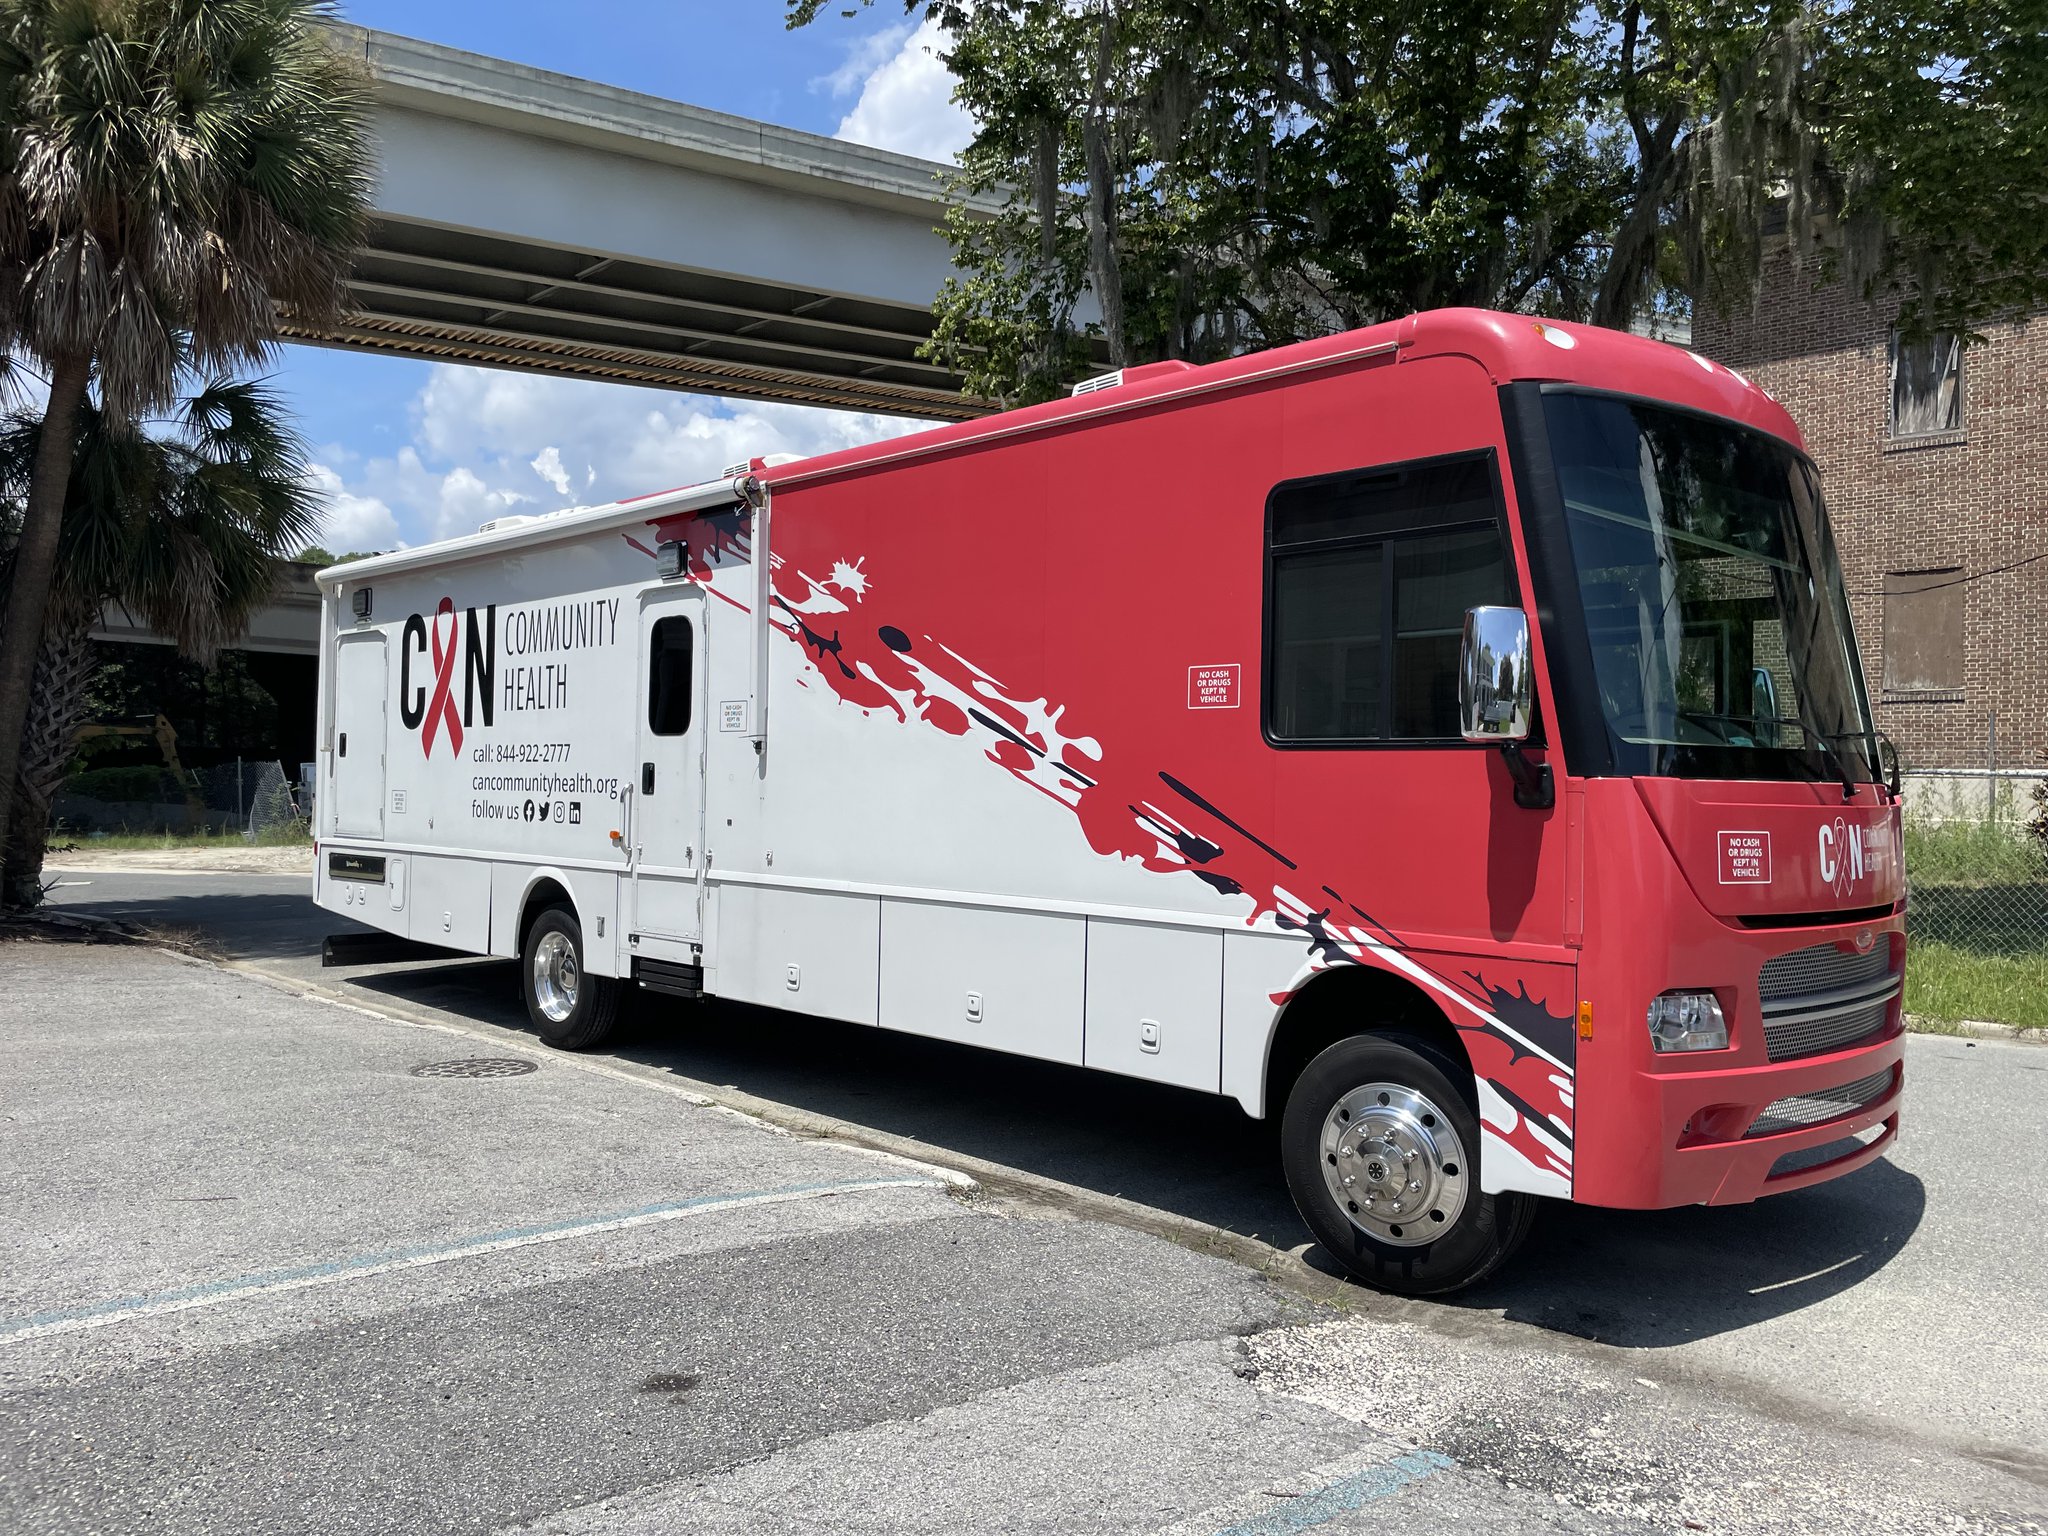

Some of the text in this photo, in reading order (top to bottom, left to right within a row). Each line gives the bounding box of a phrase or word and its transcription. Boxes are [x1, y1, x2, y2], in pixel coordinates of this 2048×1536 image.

[505, 597, 620, 656] COMMUNITY
[1199, 671, 1210, 679] NO
[1197, 678, 1231, 687] OR DRUGS
[504, 663, 568, 712] HEALTH
[1201, 687, 1217, 695] KEPT
[1200, 695, 1227, 703] VEHICLE
[473, 743, 571, 763] call: 844-922-2777
[472, 772, 618, 800] cancommunityhealth.org
[472, 799, 504, 819] follow
[507, 804, 519, 820] us
[1730, 838, 1760, 847] NO CASH
[1728, 848, 1763, 857] OR DRUGS
[1733, 858, 1759, 867] KEPT IN
[1732, 868, 1760, 877] VEHICLE
